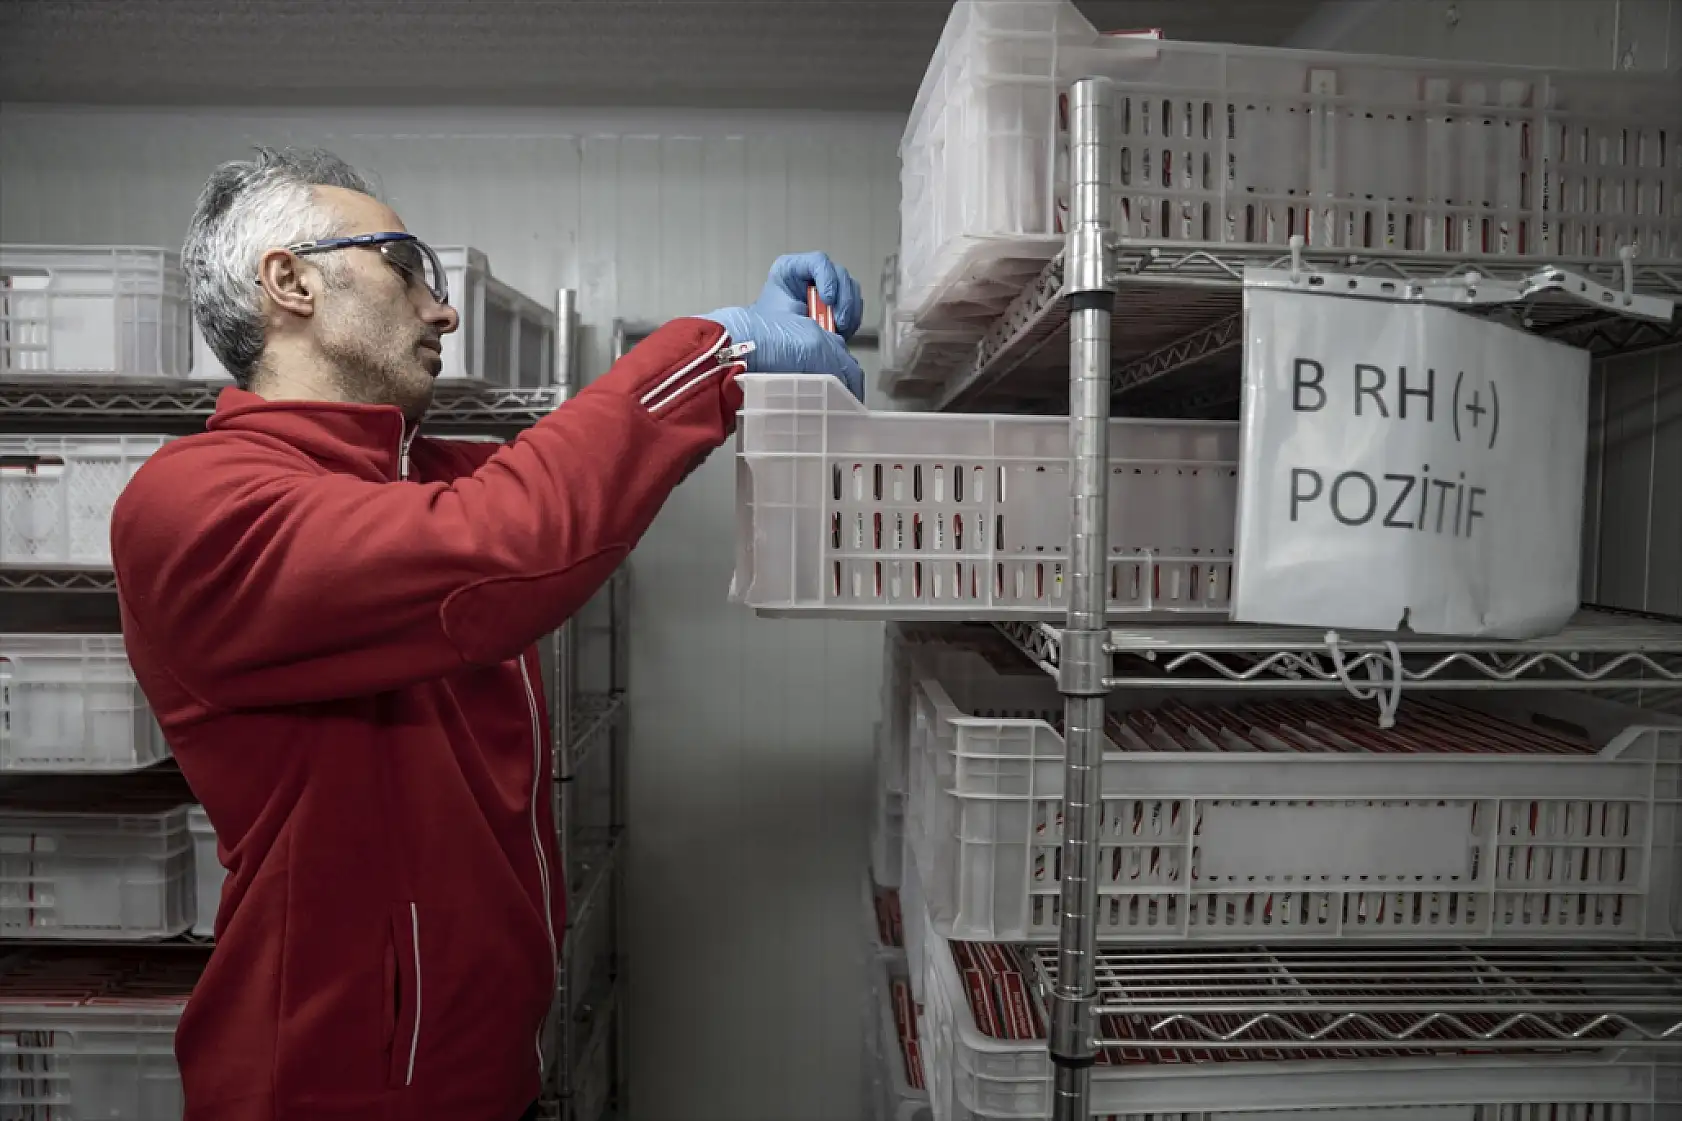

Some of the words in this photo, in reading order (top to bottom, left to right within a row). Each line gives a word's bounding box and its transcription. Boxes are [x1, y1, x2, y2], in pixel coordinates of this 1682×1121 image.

[1292, 357, 1327, 412] B
[1354, 363, 1435, 422] RH
[1289, 463, 1487, 538] POZİTİF
